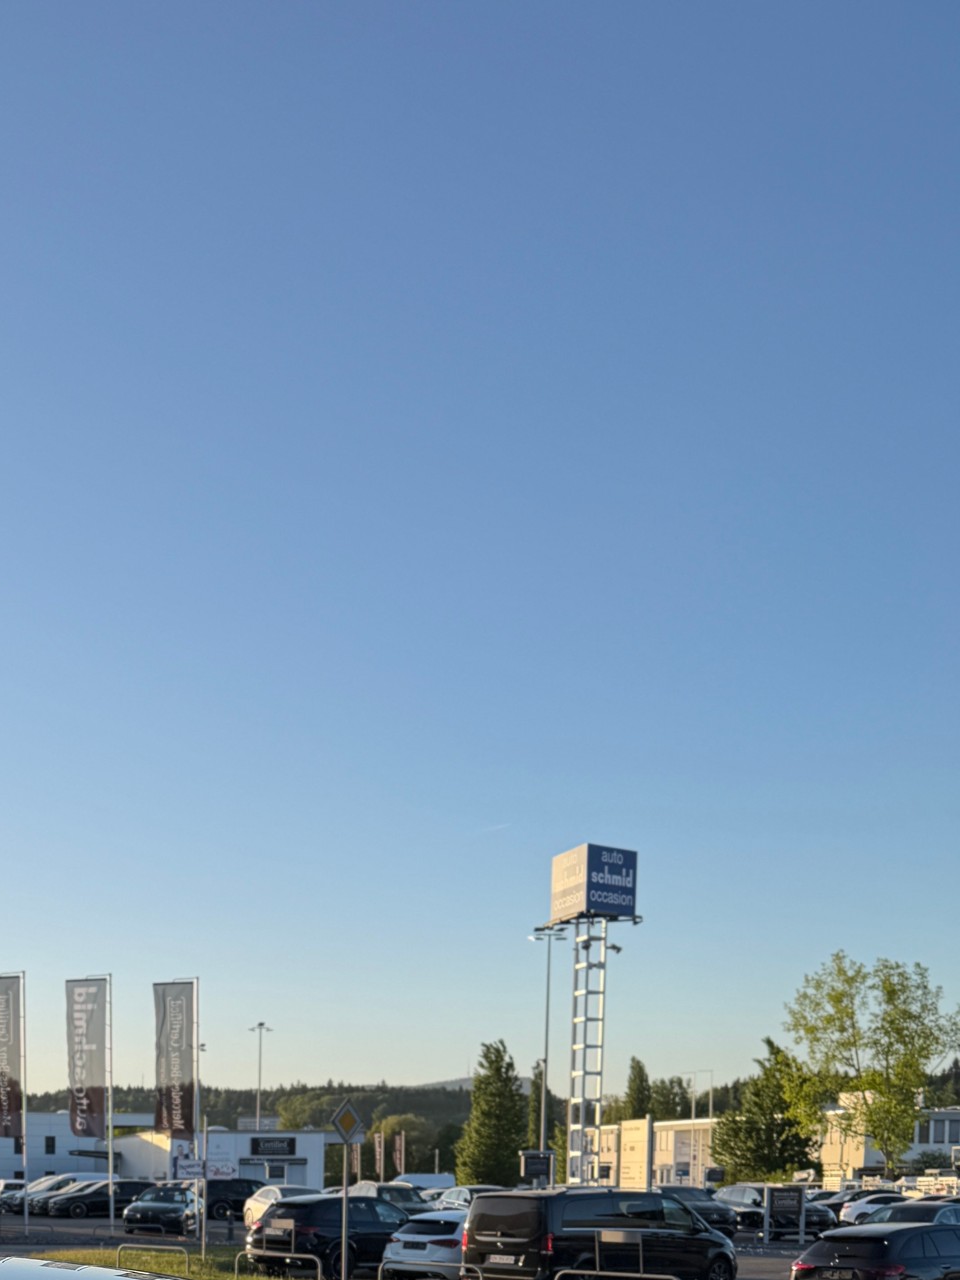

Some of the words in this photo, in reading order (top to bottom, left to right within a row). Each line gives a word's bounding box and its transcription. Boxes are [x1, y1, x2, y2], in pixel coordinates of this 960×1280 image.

[601, 850, 624, 865] auto
[591, 865, 634, 888] schmid
[554, 889, 584, 912] occasion
[589, 889, 633, 906] occasion
